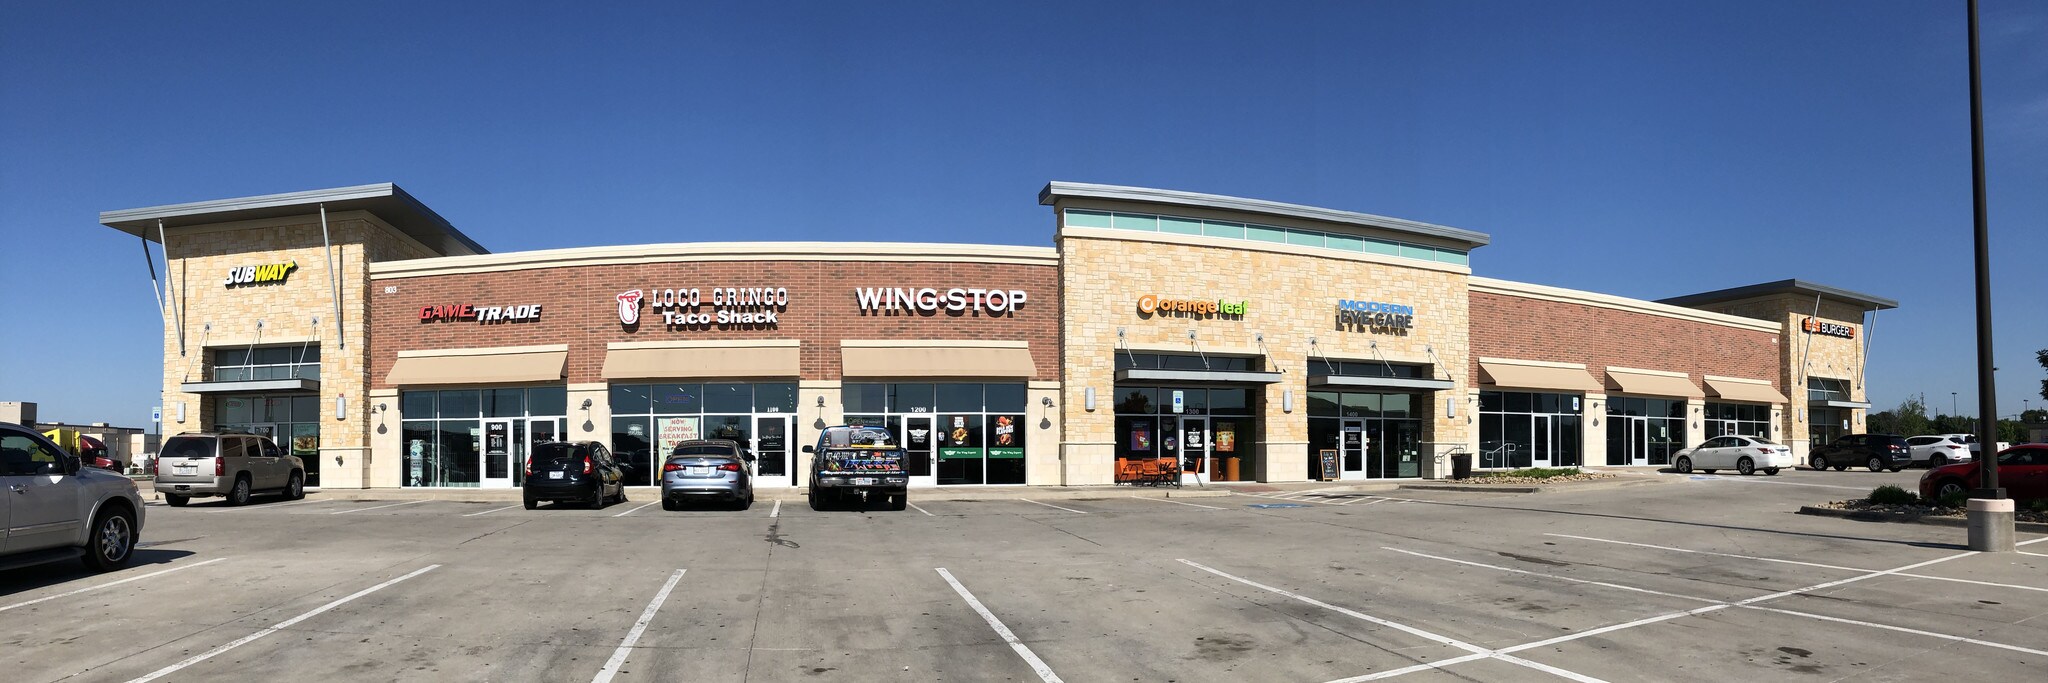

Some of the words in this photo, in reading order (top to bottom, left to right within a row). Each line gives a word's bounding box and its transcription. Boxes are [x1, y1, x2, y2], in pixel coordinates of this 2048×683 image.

[223, 259, 296, 285] SUBWAY
[385, 286, 397, 294] 803
[652, 288, 701, 307] LOCO
[713, 287, 788, 307] GRINGO
[1159, 299, 1217, 315] orange
[1219, 298, 1249, 315] leaf
[1339, 299, 1413, 316] MODERN
[662, 311, 711, 325] Taco
[717, 310, 778, 324] Shack
[1340, 309, 1373, 326] EYE
[1374, 312, 1414, 329] CARE
[1821, 322, 1850, 337] BURGER
